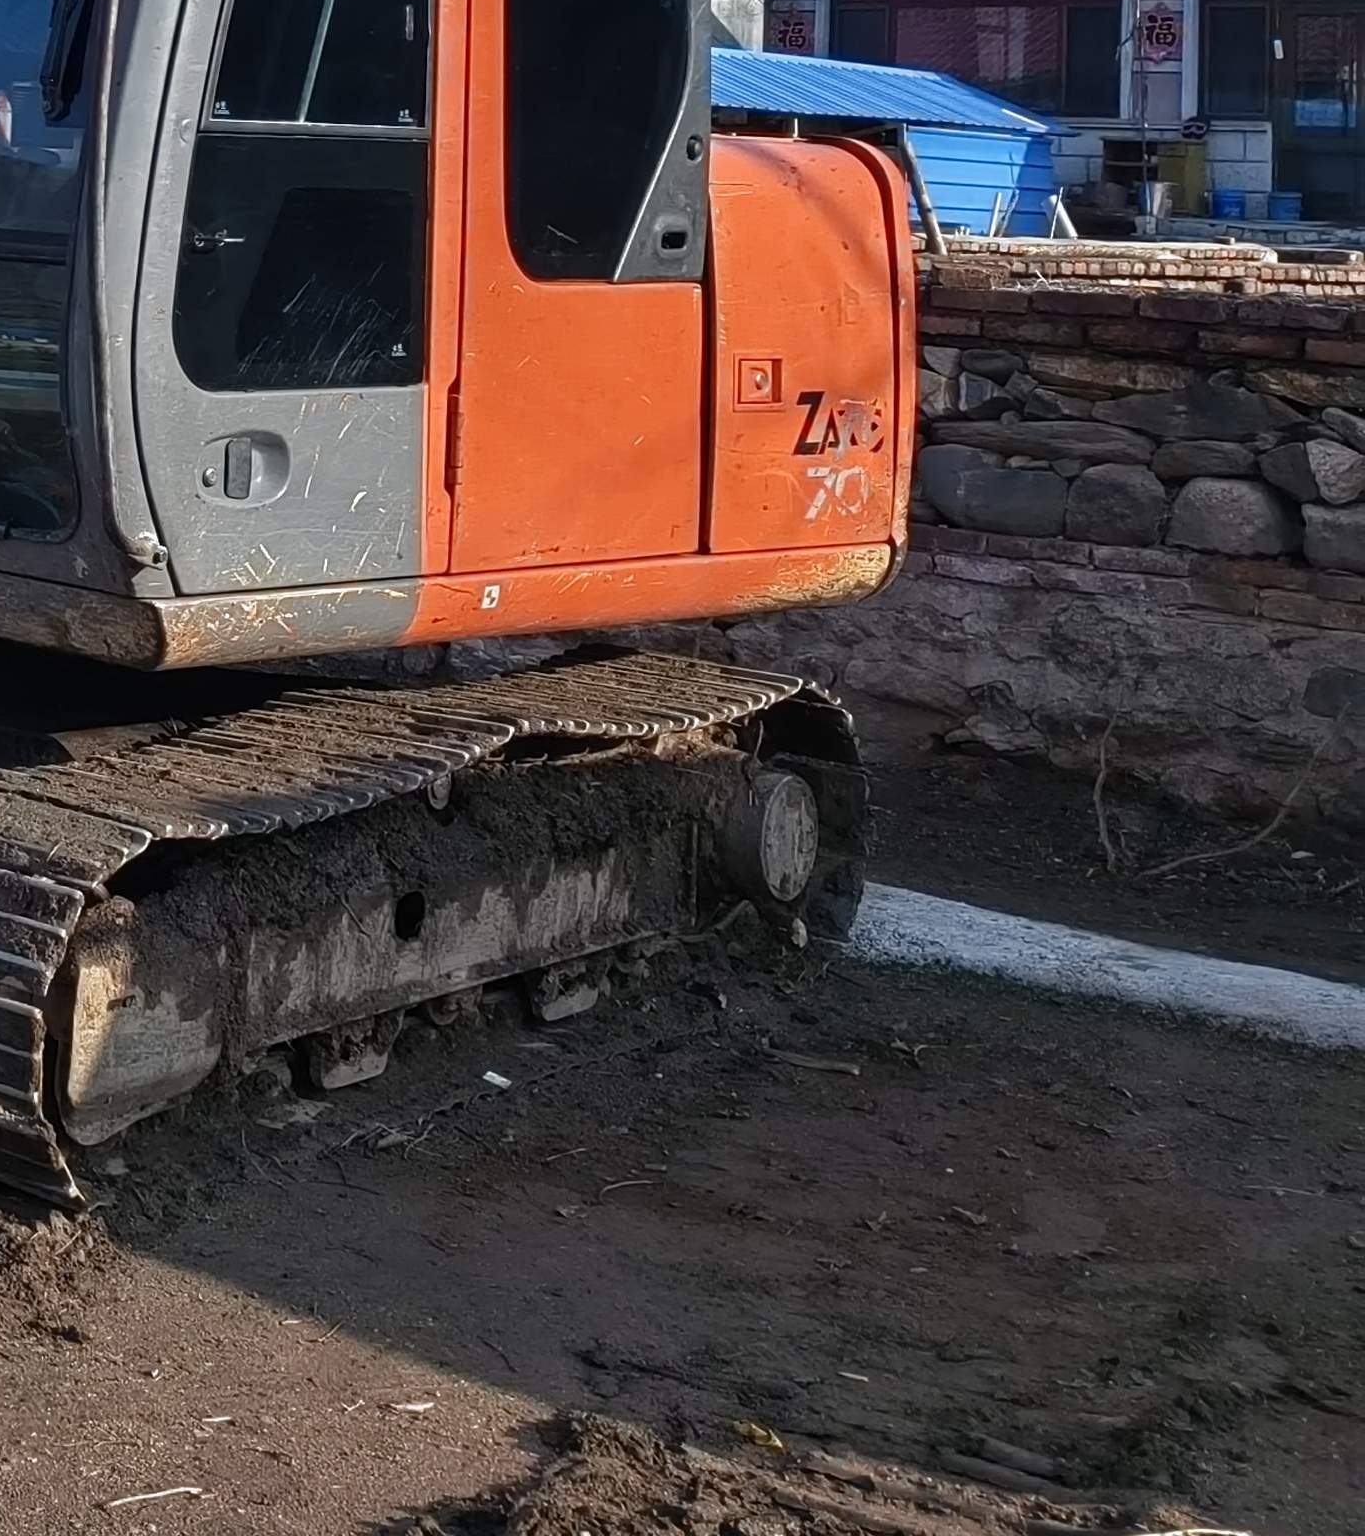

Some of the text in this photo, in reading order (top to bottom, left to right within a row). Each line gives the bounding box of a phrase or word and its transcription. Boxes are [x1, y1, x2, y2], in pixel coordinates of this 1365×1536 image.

[778, 20, 806, 48] 福
[1145, 14, 1177, 47] 福
[805, 466, 871, 520] 70
